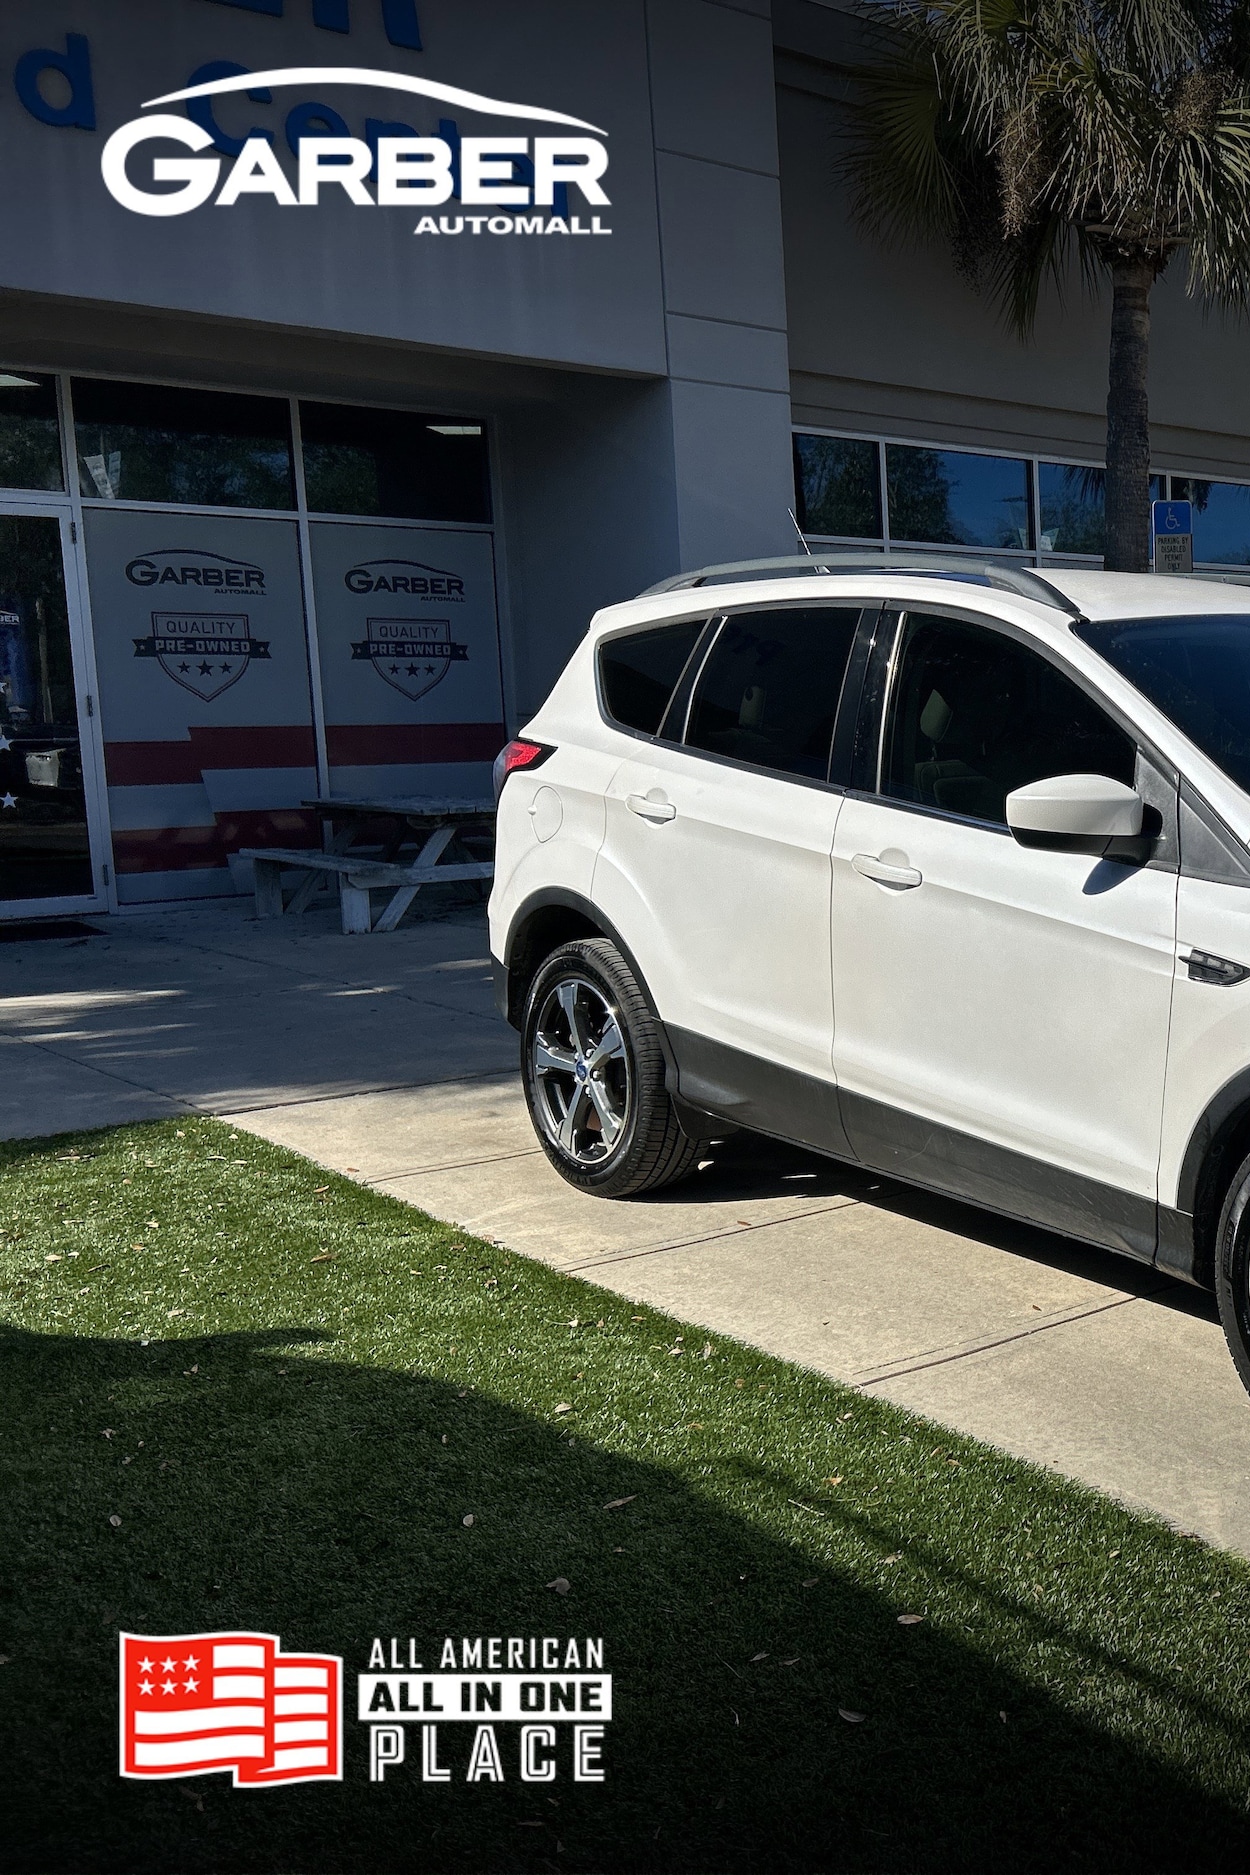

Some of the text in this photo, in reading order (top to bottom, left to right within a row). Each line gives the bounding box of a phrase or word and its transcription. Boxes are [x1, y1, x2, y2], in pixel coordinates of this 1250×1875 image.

[125, 559, 266, 588] GARBER
[344, 569, 465, 595] GARBER
[214, 588, 267, 596] AUTOMALL
[166, 620, 236, 634] QUALITY
[379, 625, 439, 639] QUALITY
[155, 639, 251, 652] PRE-OWNED
[370, 643, 451, 656] PRE-OWNED
